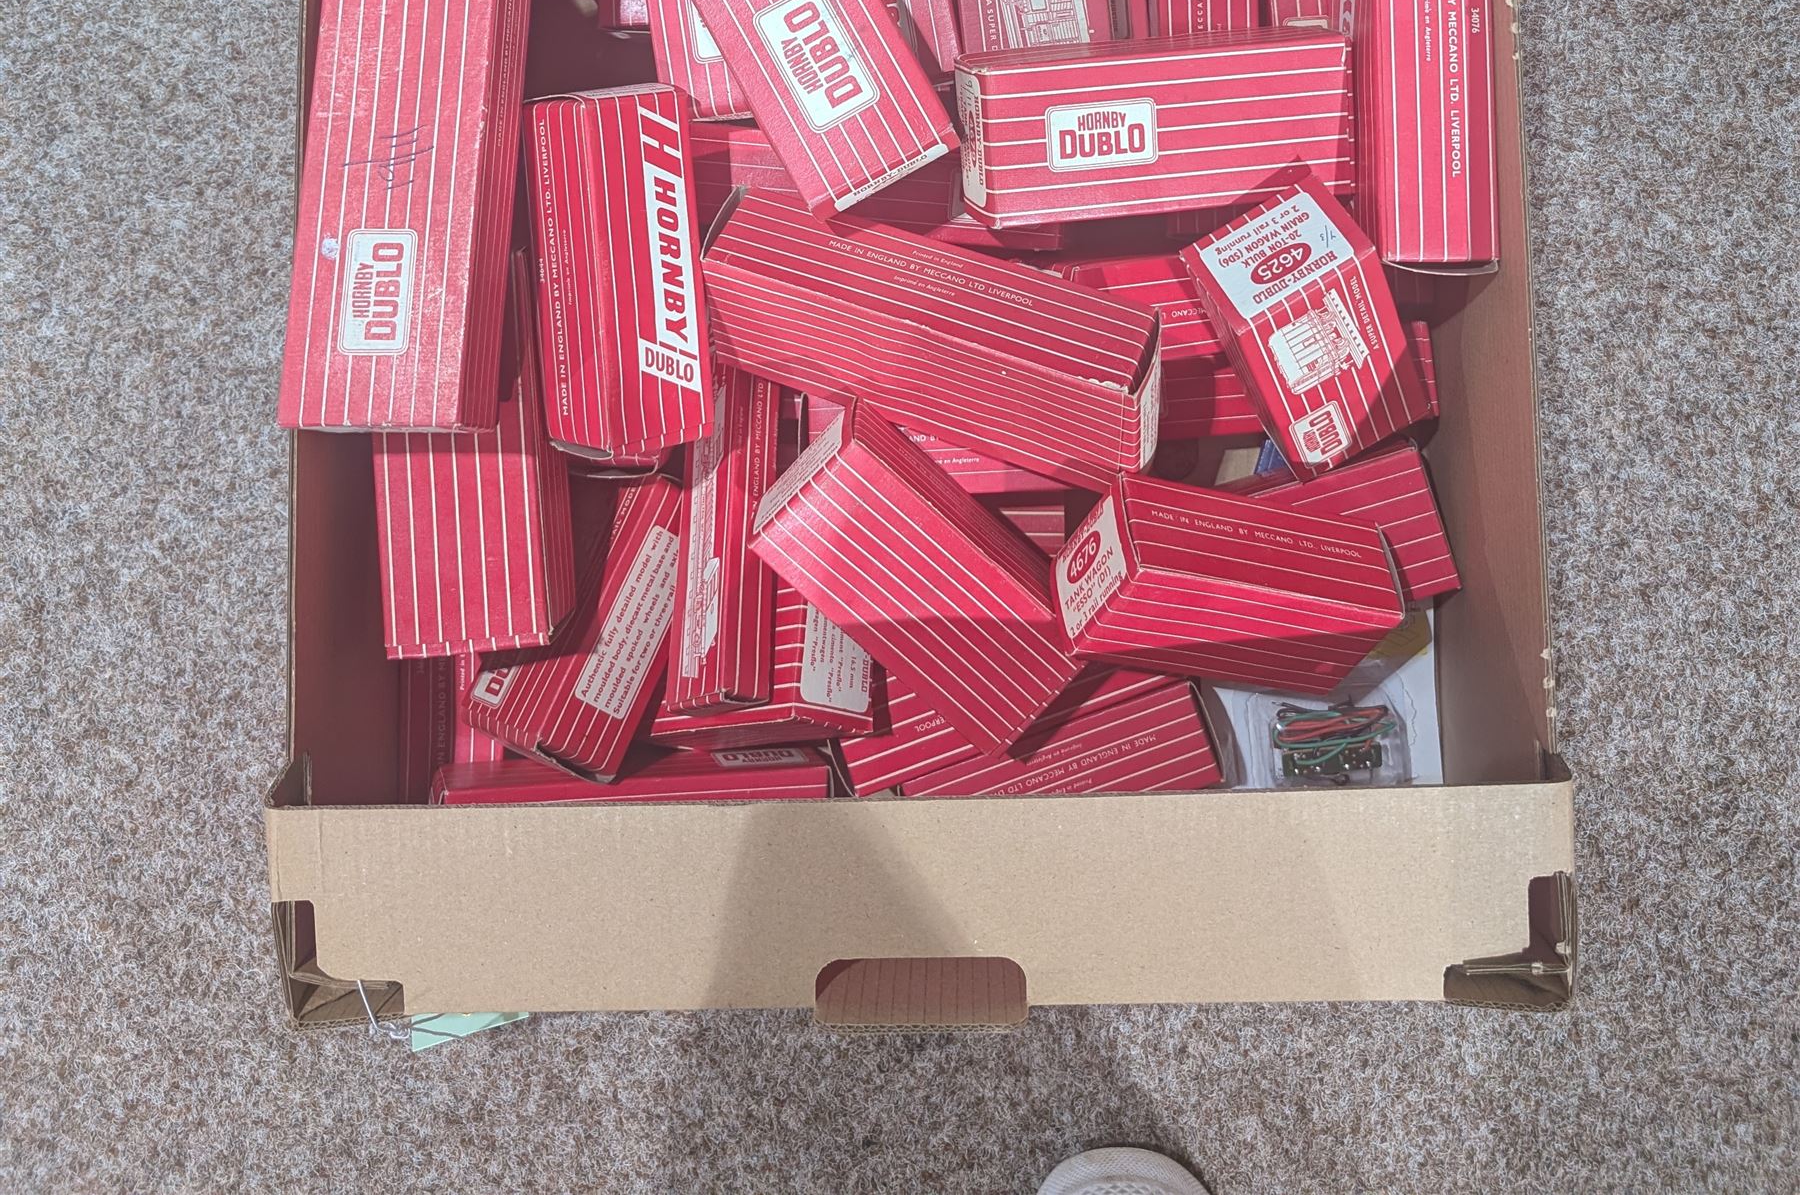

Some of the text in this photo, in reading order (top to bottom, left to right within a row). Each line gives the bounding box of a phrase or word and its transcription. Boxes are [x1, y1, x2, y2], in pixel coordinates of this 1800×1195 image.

[987, 8, 997, 41] SUPER
[1471, 7, 1480, 33] 34076
[783, 1, 863, 109] DUBLO
[1448, 12, 1458, 73] MECCANO
[781, 36, 824, 95] HORNBY
[1449, 79, 1460, 104] LTD.
[1077, 111, 1127, 132] HORNBY
[539, 119, 550, 184] LIVERPOOL
[974, 95, 983, 186] HORNBY-DUBLO
[1058, 123, 1145, 160] DUBLO
[1450, 110, 1461, 178] LIVERPOOL
[1279, 209, 1290, 219] or
[1291, 205, 1300, 213] 2
[1214, 232, 1252, 255] running
[1218, 212, 1310, 268] GRAIN WAGON (SD6)
[1253, 221, 1269, 236] rail
[548, 217, 558, 278] MECCANO
[654, 175, 688, 344] HORNBY
[912, 250, 933, 261] Printed
[940, 257, 964, 269] England
[1243, 229, 1302, 267] 20-TON BULK
[1257, 247, 1304, 280] 4625
[352, 262, 375, 318] HORNBY
[553, 283, 560, 297] BY
[829, 239, 852, 252] MADE
[866, 251, 907, 267] ENGLAND
[909, 263, 920, 271] BY
[923, 267, 966, 285] MECCANO
[968, 281, 985, 291] LTD
[988, 287, 1034, 307] LIVERPOOL
[1253, 250, 1338, 305] HORNBY-DUBLO
[1350, 275, 1362, 299] MODEL
[364, 242, 404, 341] DUBLO
[1358, 300, 1370, 323] DETAIL
[554, 301, 564, 360] ENGLAND
[1366, 324, 1378, 345] SUPER
[560, 365, 566, 378] IN
[644, 347, 694, 383] DUBLO
[755, 441, 761, 454] BY
[1302, 429, 1320, 452] HORNBY
[1309, 410, 1342, 455] DUBLO
[1069, 537, 1097, 578] 4676
[1065, 546, 1114, 611] TANK WAGON
[1097, 564, 1112, 589] (D1)
[581, 530, 664, 698] Authentic fully detailed model with
[594, 536, 675, 703] moulded body, diecast metal base and
[1070, 571, 1123, 636] 2 or 3 rail running
[605, 667, 626, 709] moulded
[626, 629, 643, 662] spoked
[643, 593, 660, 624] wheels
[659, 572, 670, 589] and
[613, 585, 676, 715] Suitable for two or three rail
[722, 750, 794, 762] DUBLO
[1080, 748, 1119, 767] ENGLAND
[1121, 743, 1132, 752] IN
[1134, 734, 1157, 747] MADE
[1025, 767, 1065, 787] MECCANO
[1067, 761, 1078, 770] BY
[1008, 782, 1024, 794] LTD
